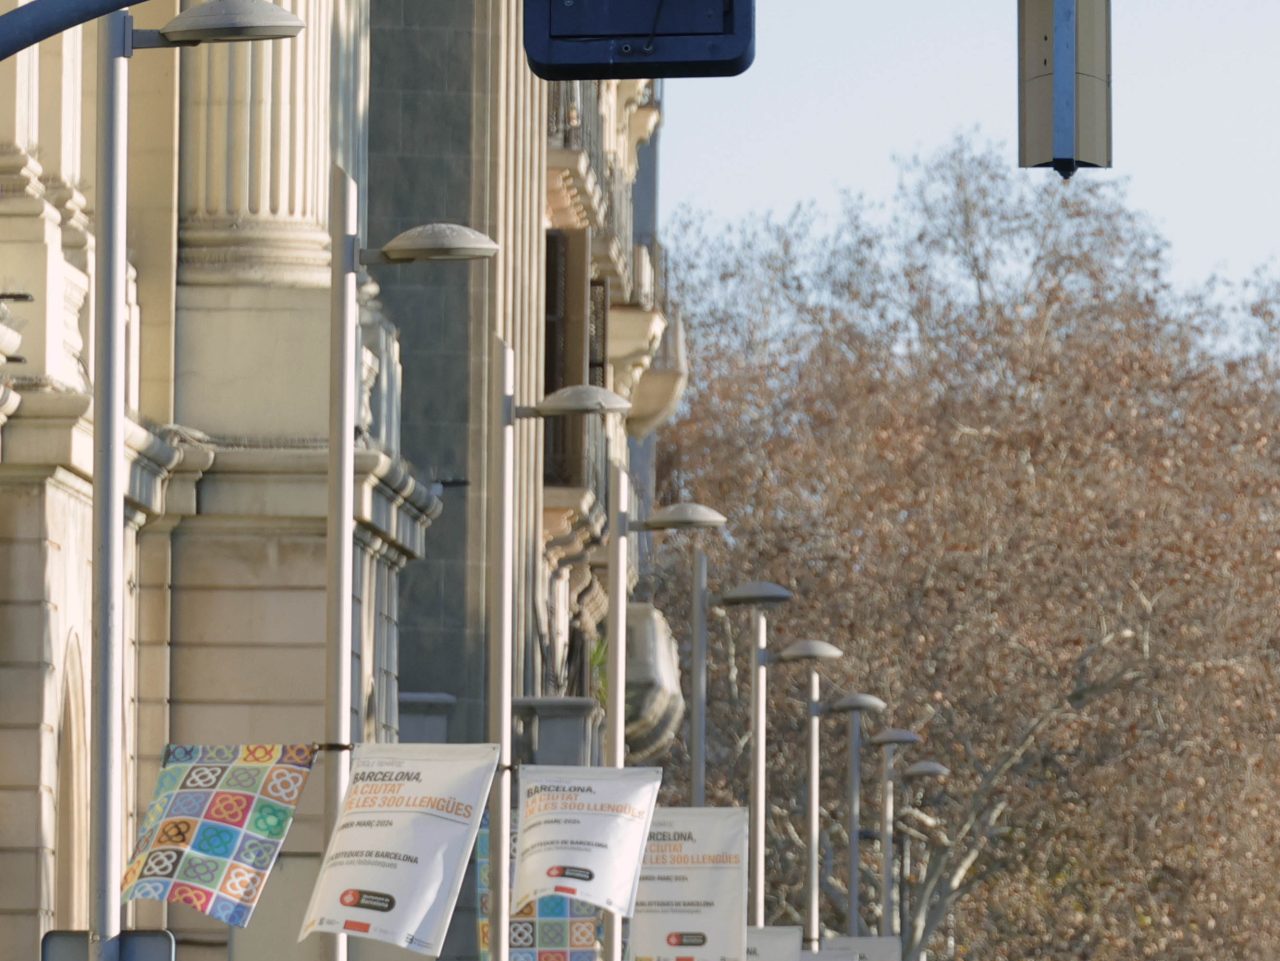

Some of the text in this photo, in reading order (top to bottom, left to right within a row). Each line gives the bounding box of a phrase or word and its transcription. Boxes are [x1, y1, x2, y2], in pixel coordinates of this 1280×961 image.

[360, 784, 405, 795] CIUTAT
[356, 797, 378, 808] LES
[378, 796, 405, 808] 300
[405, 796, 473, 819] LLENGÜES
[648, 832, 696, 843] RCELONA,
